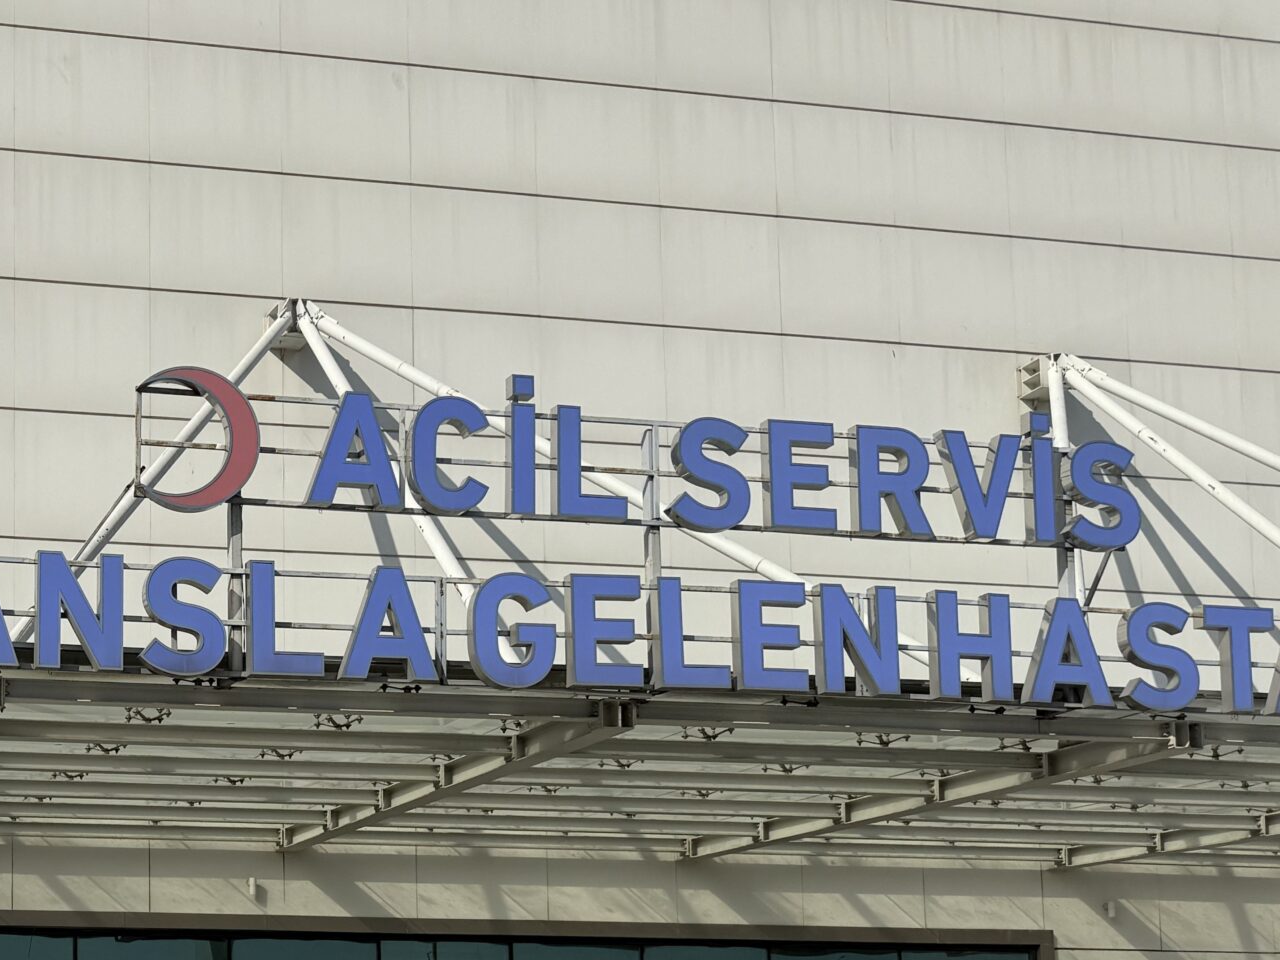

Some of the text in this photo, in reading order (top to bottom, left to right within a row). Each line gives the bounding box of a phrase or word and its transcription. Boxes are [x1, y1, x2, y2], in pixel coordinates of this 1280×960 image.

[307, 373, 1142, 552] ACİL SERVİS
[928, 589, 1280, 715] HAST
